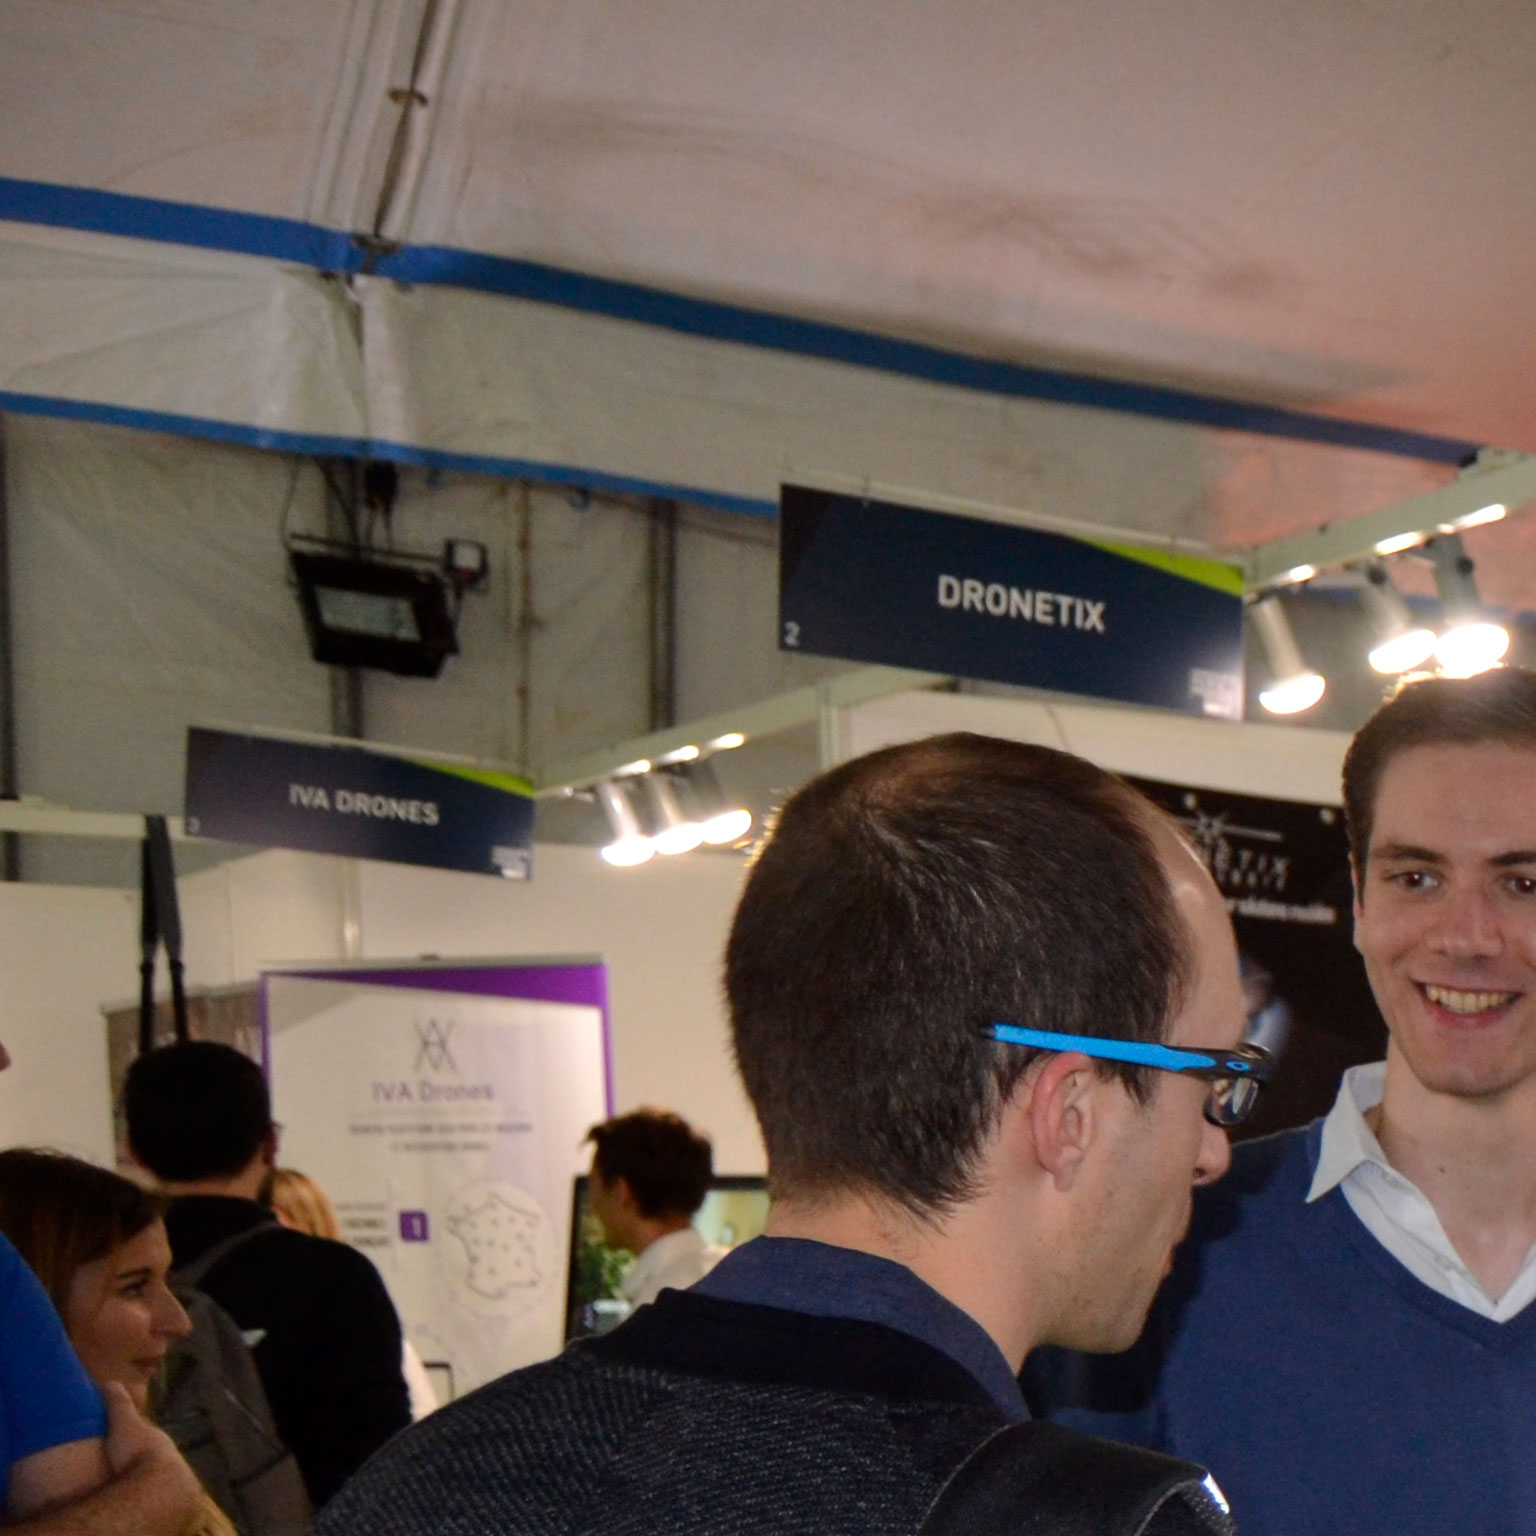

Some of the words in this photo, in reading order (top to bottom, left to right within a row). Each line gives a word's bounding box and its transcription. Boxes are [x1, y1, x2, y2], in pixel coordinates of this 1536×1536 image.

[937, 574, 1106, 633] DRONETIX
[784, 621, 800, 647] 2
[288, 783, 331, 811] IVA
[335, 789, 439, 826] DRONES
